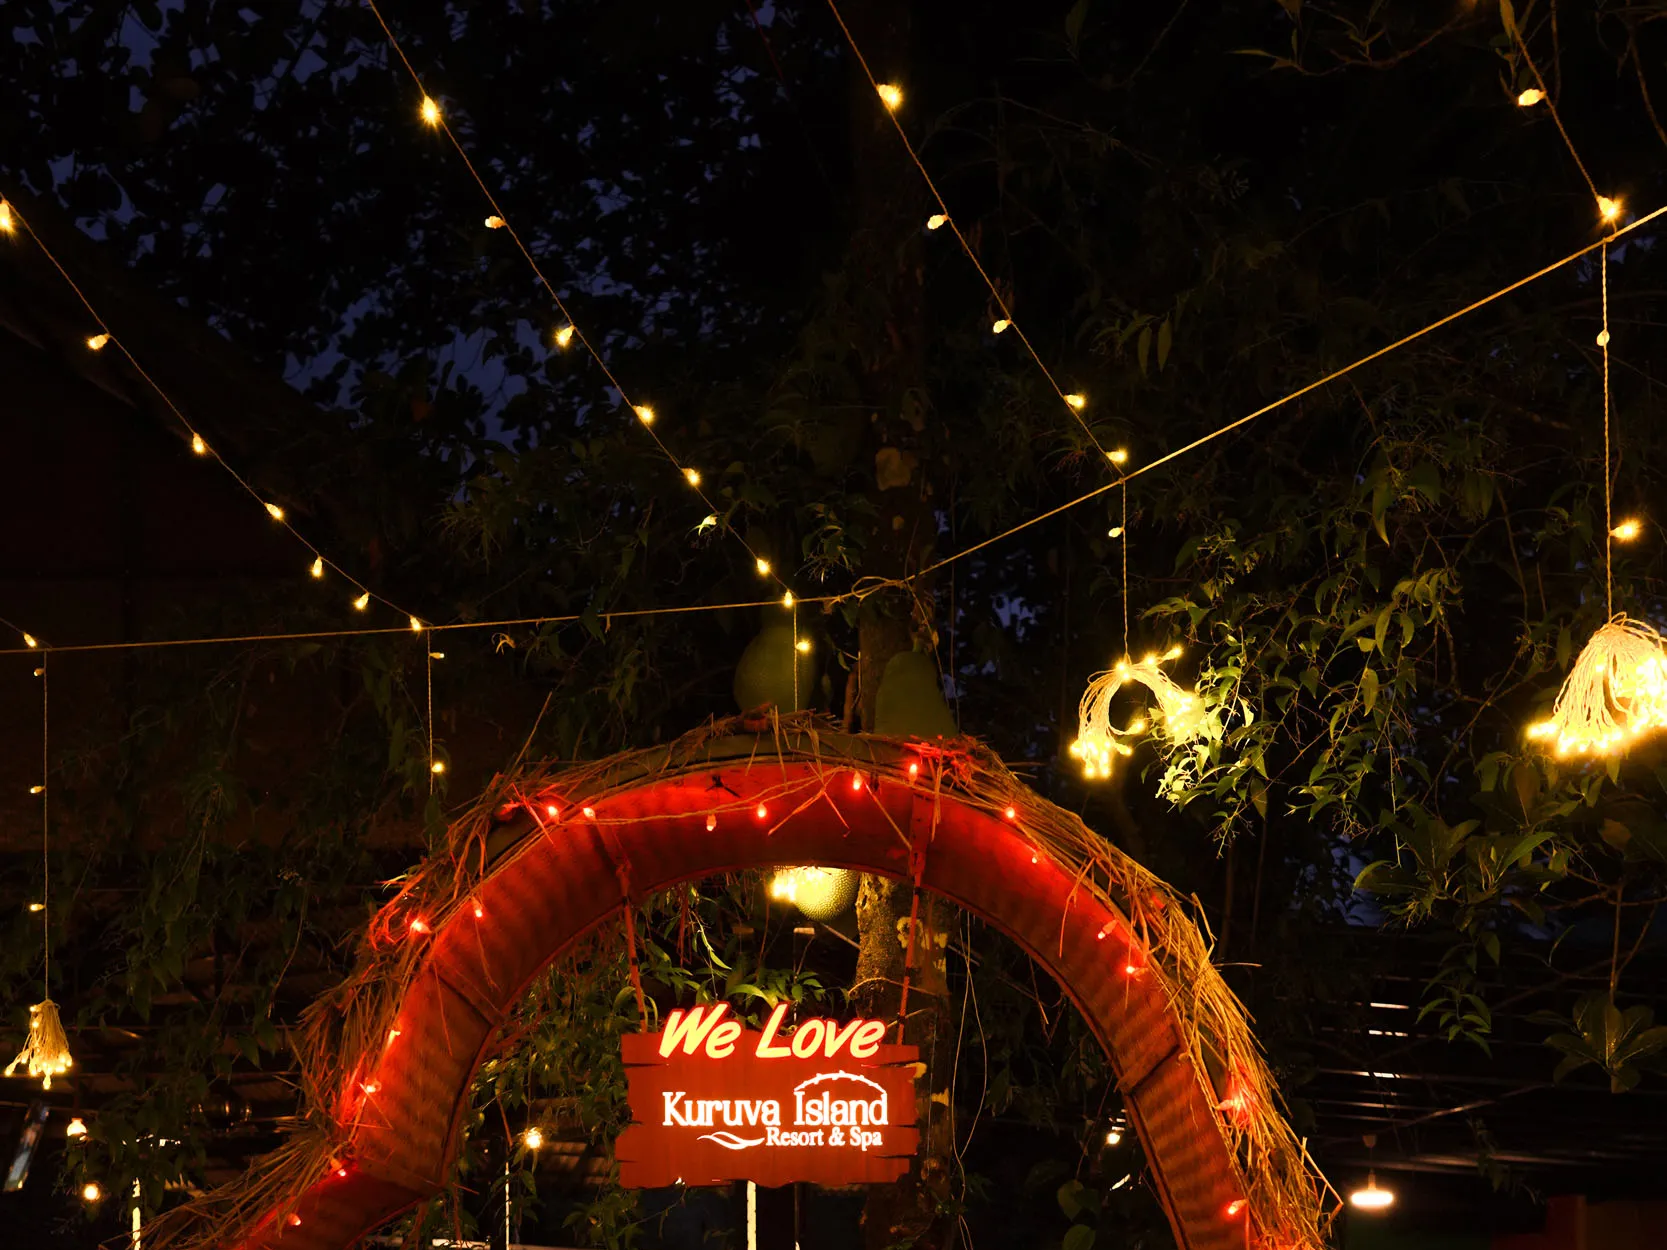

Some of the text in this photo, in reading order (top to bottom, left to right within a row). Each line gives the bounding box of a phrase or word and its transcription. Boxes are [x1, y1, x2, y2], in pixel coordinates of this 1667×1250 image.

[658, 1002, 886, 1059] We Love
[662, 1091, 888, 1126] Kuruva Island
[765, 1126, 882, 1151] Resort & Spa
